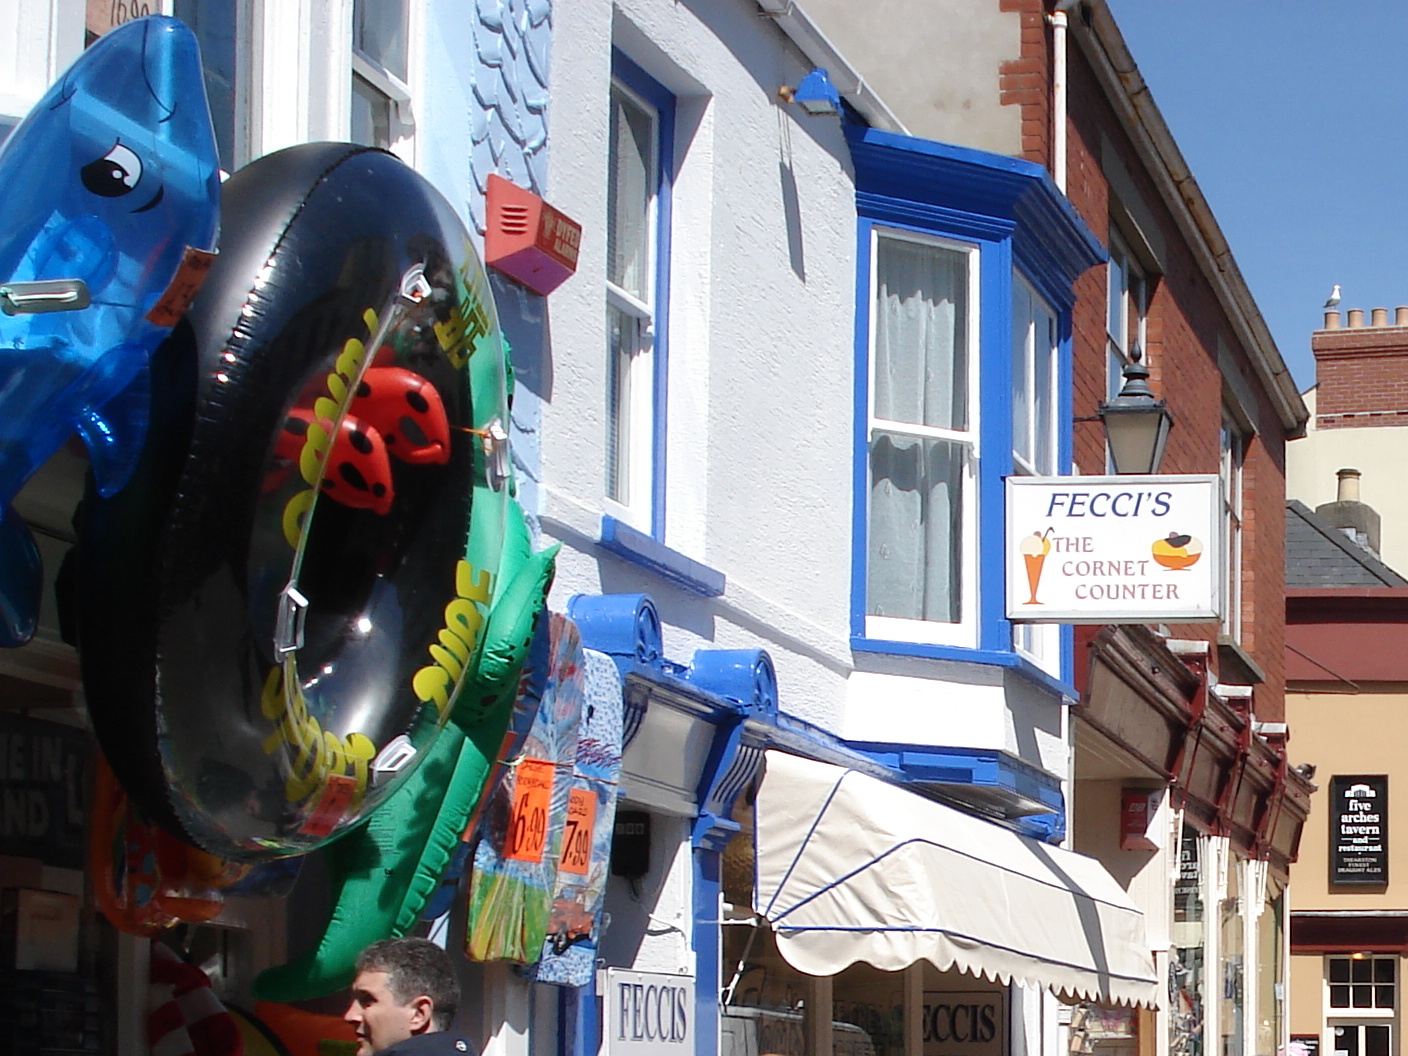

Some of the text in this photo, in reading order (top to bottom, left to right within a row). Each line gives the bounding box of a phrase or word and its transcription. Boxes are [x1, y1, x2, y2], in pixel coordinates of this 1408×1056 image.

[1046, 491, 1172, 517] FECCI'S
[1052, 537, 1094, 553] THE
[1062, 560, 1149, 577] CORNET
[1075, 583, 1180, 600] COUNTER
[1348, 799, 1372, 812] five
[1340, 811, 1380, 823] arches
[1341, 824, 1380, 835] tavern
[1338, 844, 1382, 852] restaurant
[617, 982, 687, 1042] FECCIS
[923, 1003, 995, 1042] ECCIS
